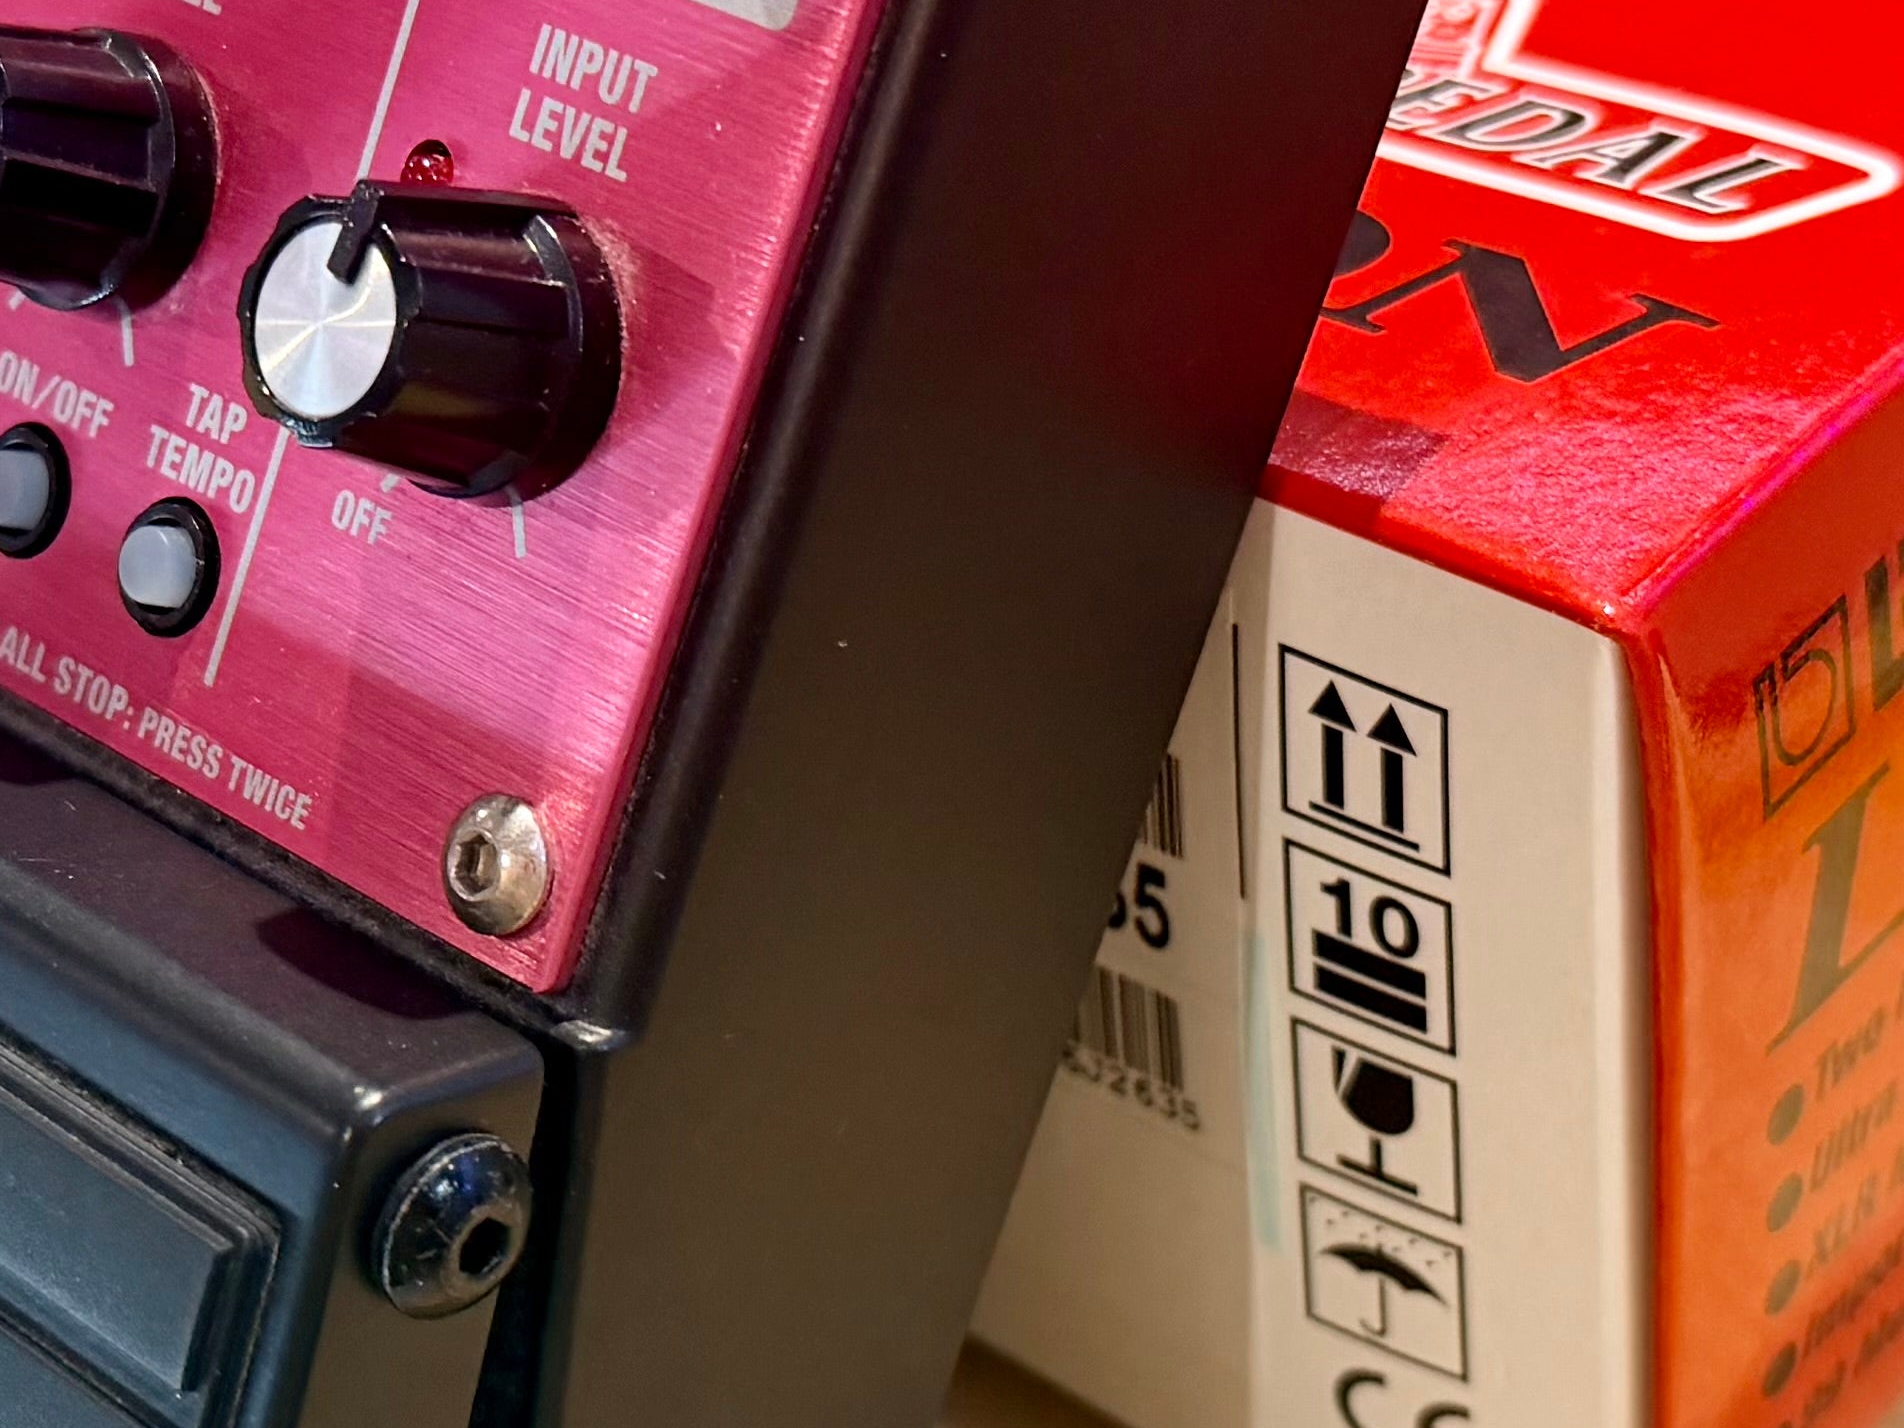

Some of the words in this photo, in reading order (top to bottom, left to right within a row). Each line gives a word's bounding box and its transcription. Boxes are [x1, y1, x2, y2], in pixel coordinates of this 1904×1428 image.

[529, 24, 658, 114] INPUT
[509, 87, 628, 183] LEVEL
[187, 383, 248, 444] TAP
[146, 426, 257, 515] TEMPO
[331, 490, 393, 546] OFF
[54, 656, 135, 732] STOP:
[139, 705, 223, 782] PRESS
[228, 757, 315, 831] TWICE
[1319, 877, 1421, 961] 10
[1815, 1005, 1887, 1102] Two
[1809, 1080, 1896, 1194] Ultra
